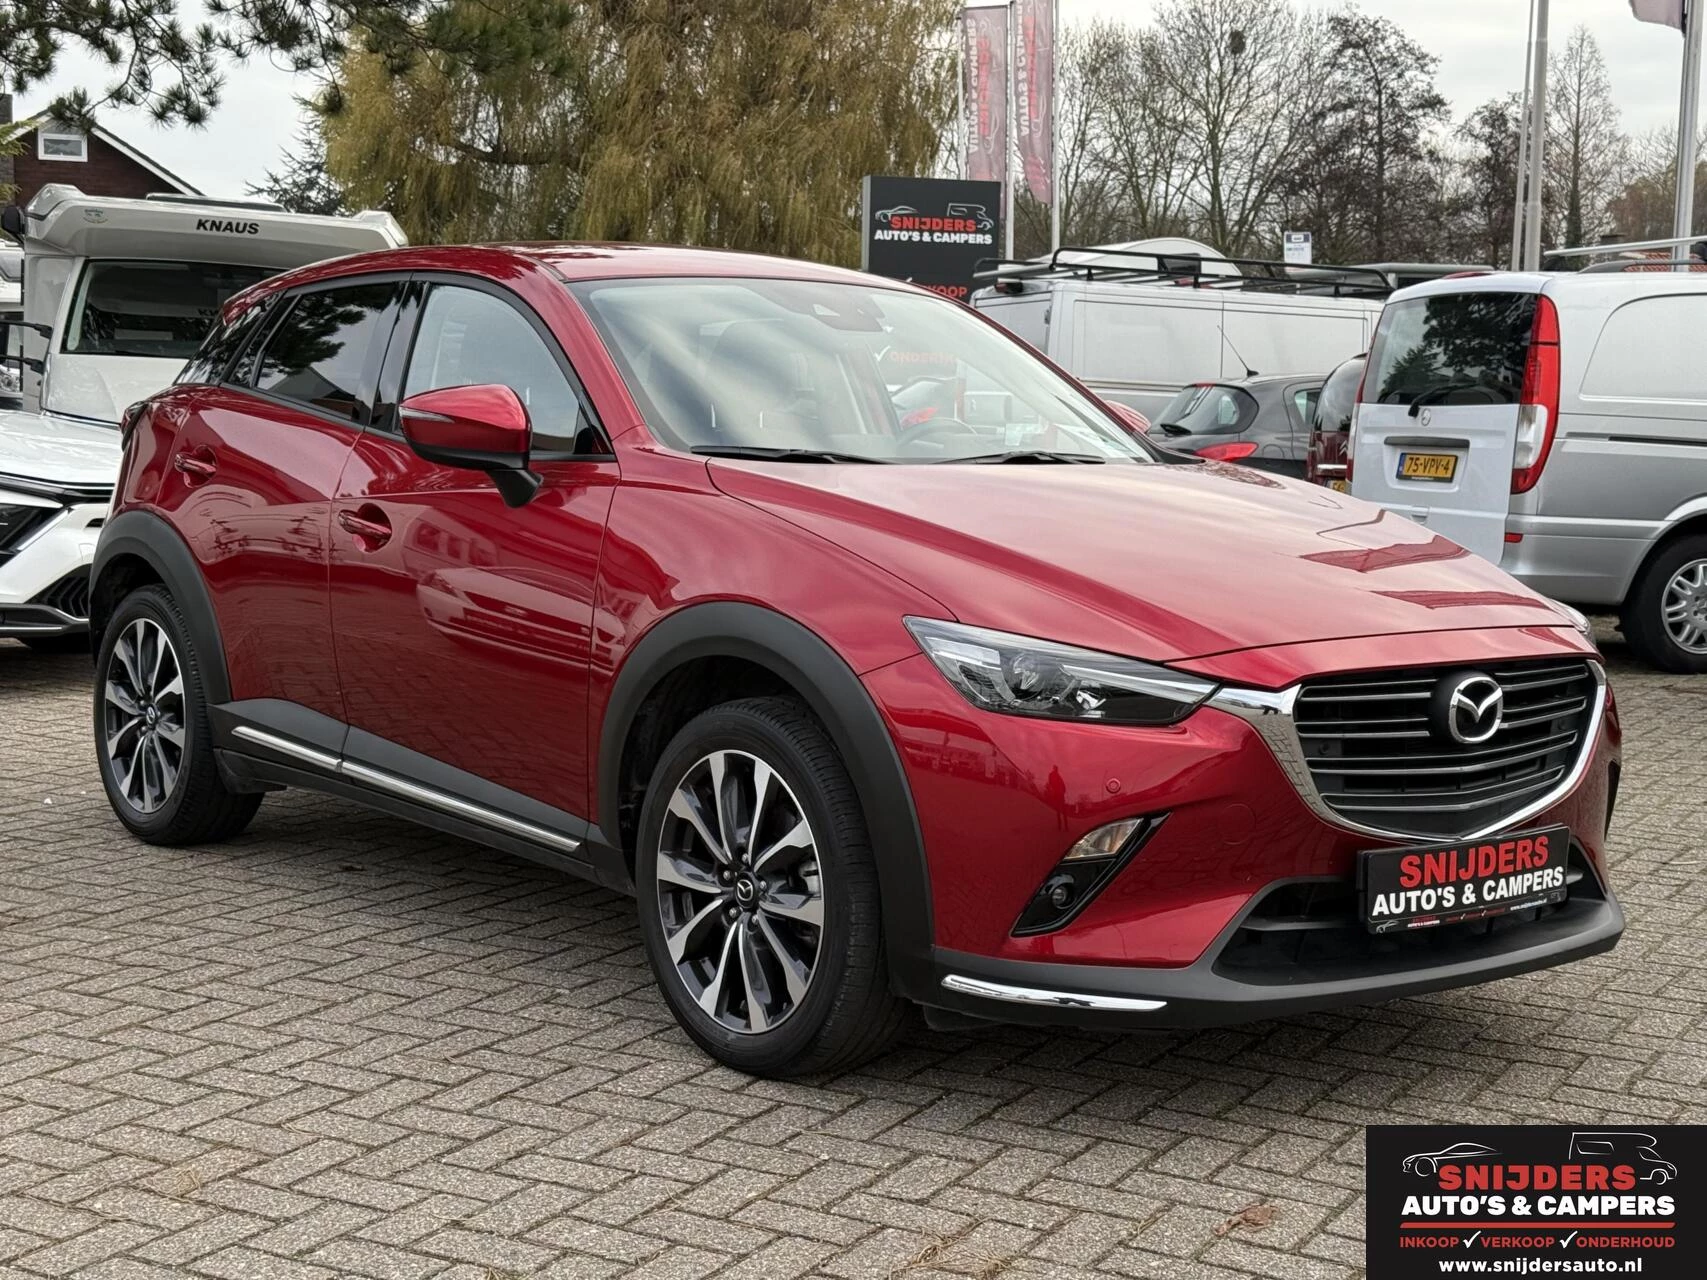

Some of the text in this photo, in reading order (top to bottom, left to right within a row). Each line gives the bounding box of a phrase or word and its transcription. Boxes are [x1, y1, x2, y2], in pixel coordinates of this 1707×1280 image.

[196, 218, 260, 235] KNAUS
[890, 216, 977, 232] SNIJDERS
[874, 230, 993, 245] AUTO'S & CAMPERS
[1406, 457, 1450, 475] 75-VPV-4
[1400, 835, 1549, 888] SNIJDERS
[1372, 886, 1456, 916] AUTO'S
[1461, 883, 1476, 905] &
[1482, 866, 1564, 901] CAMPERS
